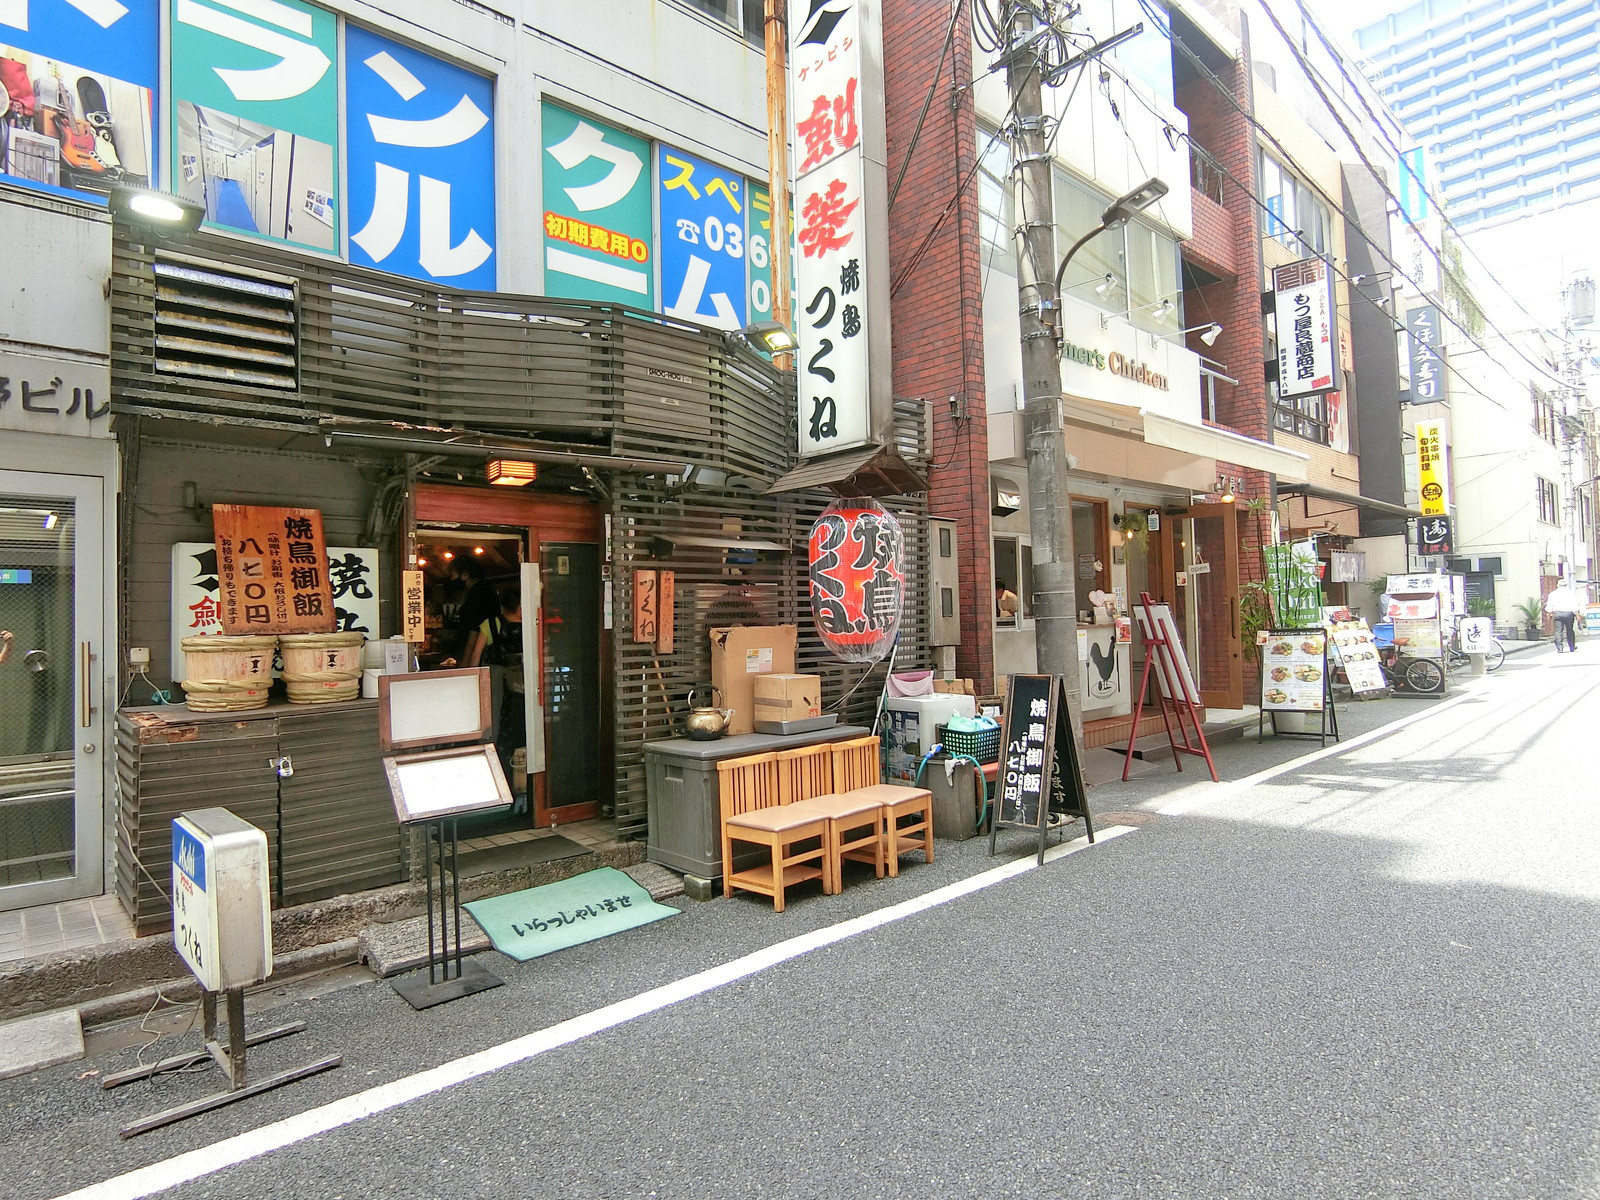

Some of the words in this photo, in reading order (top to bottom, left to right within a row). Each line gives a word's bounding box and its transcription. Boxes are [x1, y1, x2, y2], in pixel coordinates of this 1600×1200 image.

[840, 258, 862, 340] 焼鳥
[1293, 293, 1315, 381] もつ屋良蔵商店
[805, 286, 838, 442] つくね
[1108, 351, 1169, 392] Chicken
[284, 516, 324, 617] 焼鳥御飯
[809, 514, 856, 635] つくね
[1190, 564, 1209, 573] open
[1023, 698, 1048, 793] 焼鳥御飯
[180, 923, 203, 969] つくね
[511, 895, 632, 937] いらっしゃいませ
